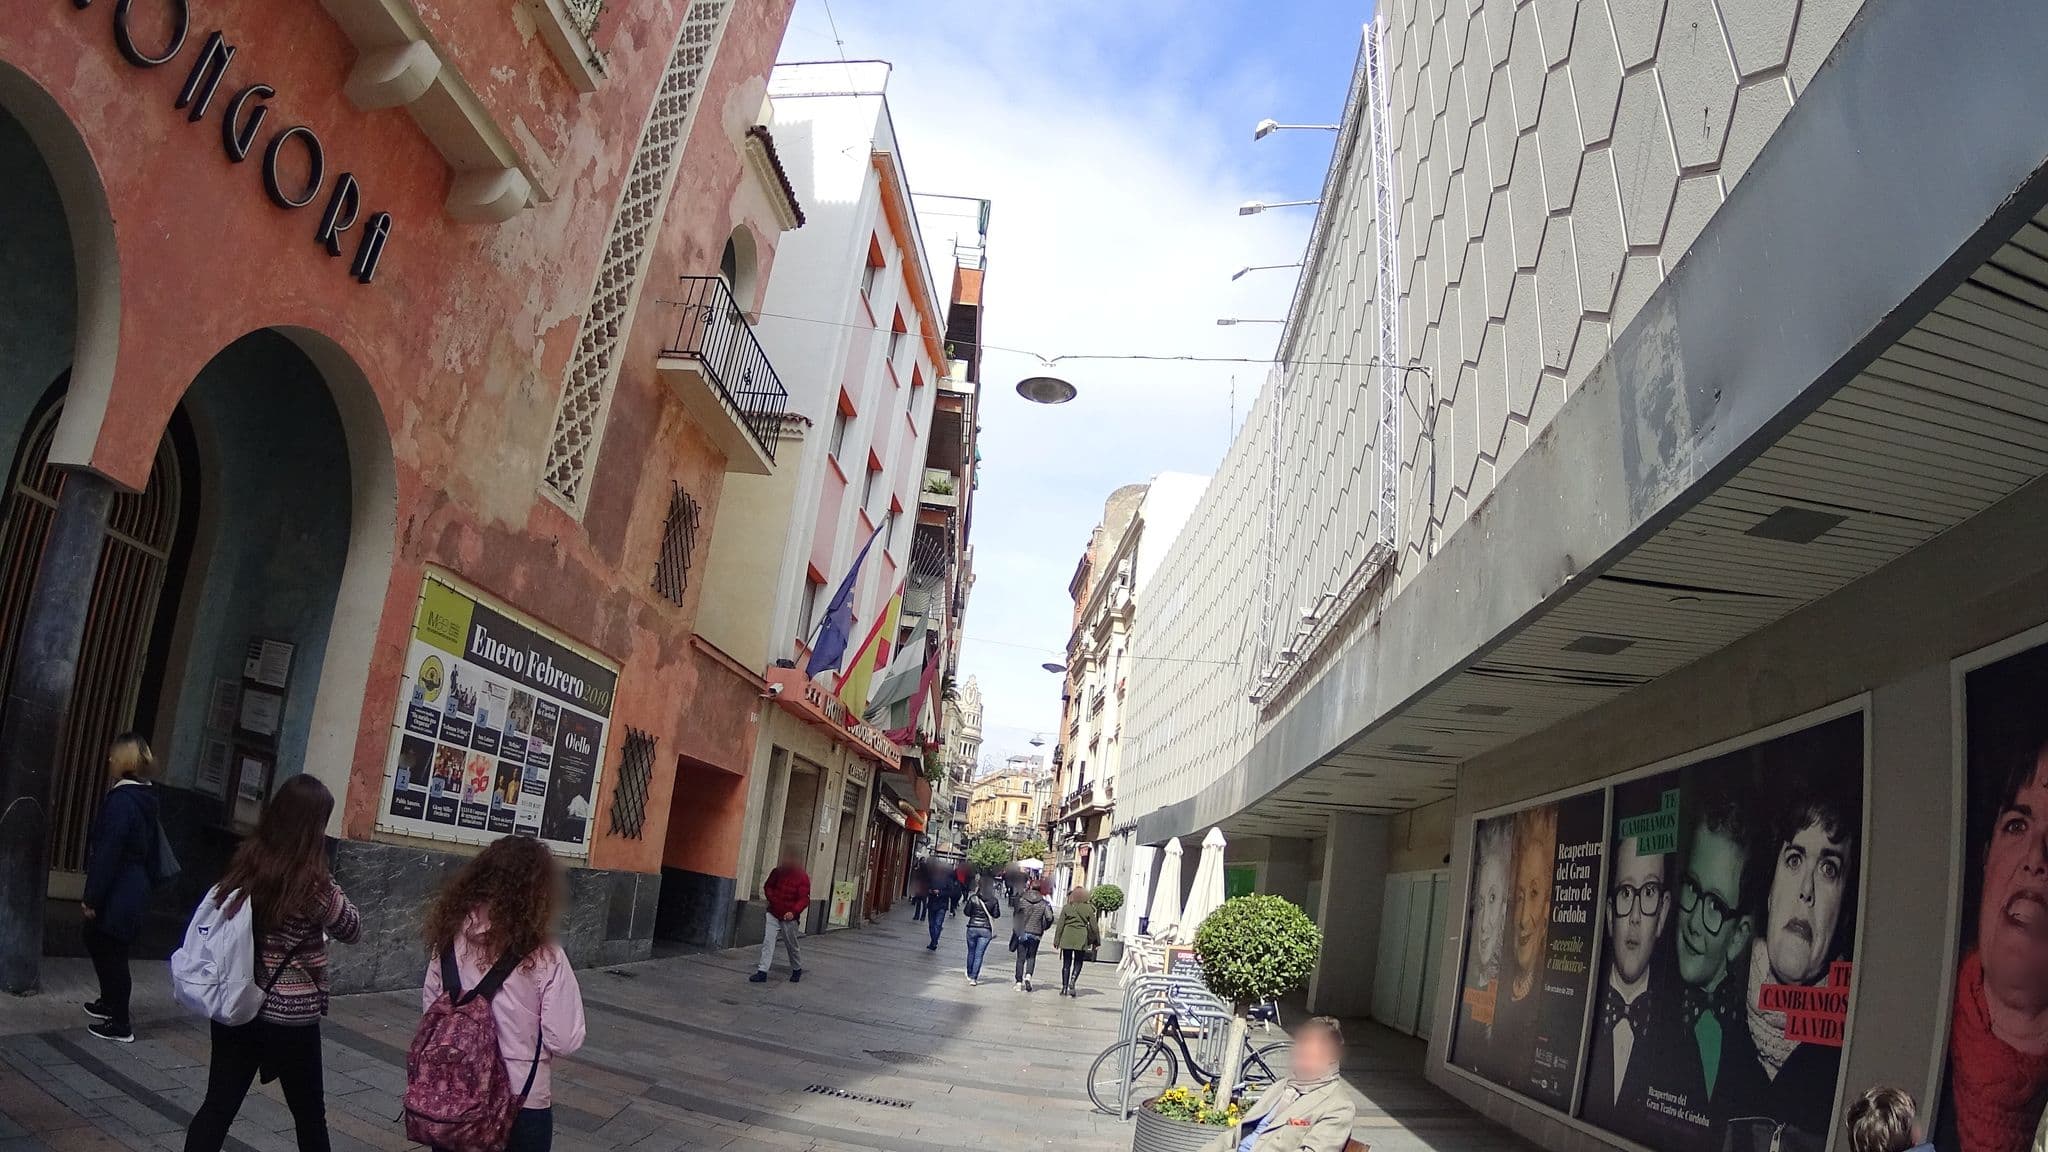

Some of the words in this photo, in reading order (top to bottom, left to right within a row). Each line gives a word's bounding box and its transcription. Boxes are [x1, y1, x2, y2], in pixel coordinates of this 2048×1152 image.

[72, 0, 393, 284] ONGORA
[471, 624, 524, 673] Enero
[525, 650, 585, 699] Febrero
[582, 684, 610, 712] 2019
[1664, 791, 1678, 809] TE
[1621, 815, 1676, 837] CAMBIAMOS
[1558, 841, 1603, 861] Reapertura
[1640, 836, 1651, 852] LA
[1651, 832, 1675, 850] VIDA
[1556, 865, 1569, 881] del
[1569, 863, 1591, 880] Gran
[1554, 884, 1580, 902] Teatro
[1580, 883, 1592, 901] de
[1552, 904, 1587, 924] Córdoba
[1763, 988, 1848, 1014] CAMBIAMOS
[1790, 1015, 1808, 1037] LA
[1810, 1018, 1845, 1041] VIDA
[1648, 1086, 1677, 1103] Reapertura
[1677, 1094, 1687, 1106] del
[1647, 1098, 1660, 1111] Gran
[1660, 1102, 1677, 1117] Teatro
[1677, 1107, 1685, 1119] de
[1684, 1109, 1710, 1127] Córdoba
